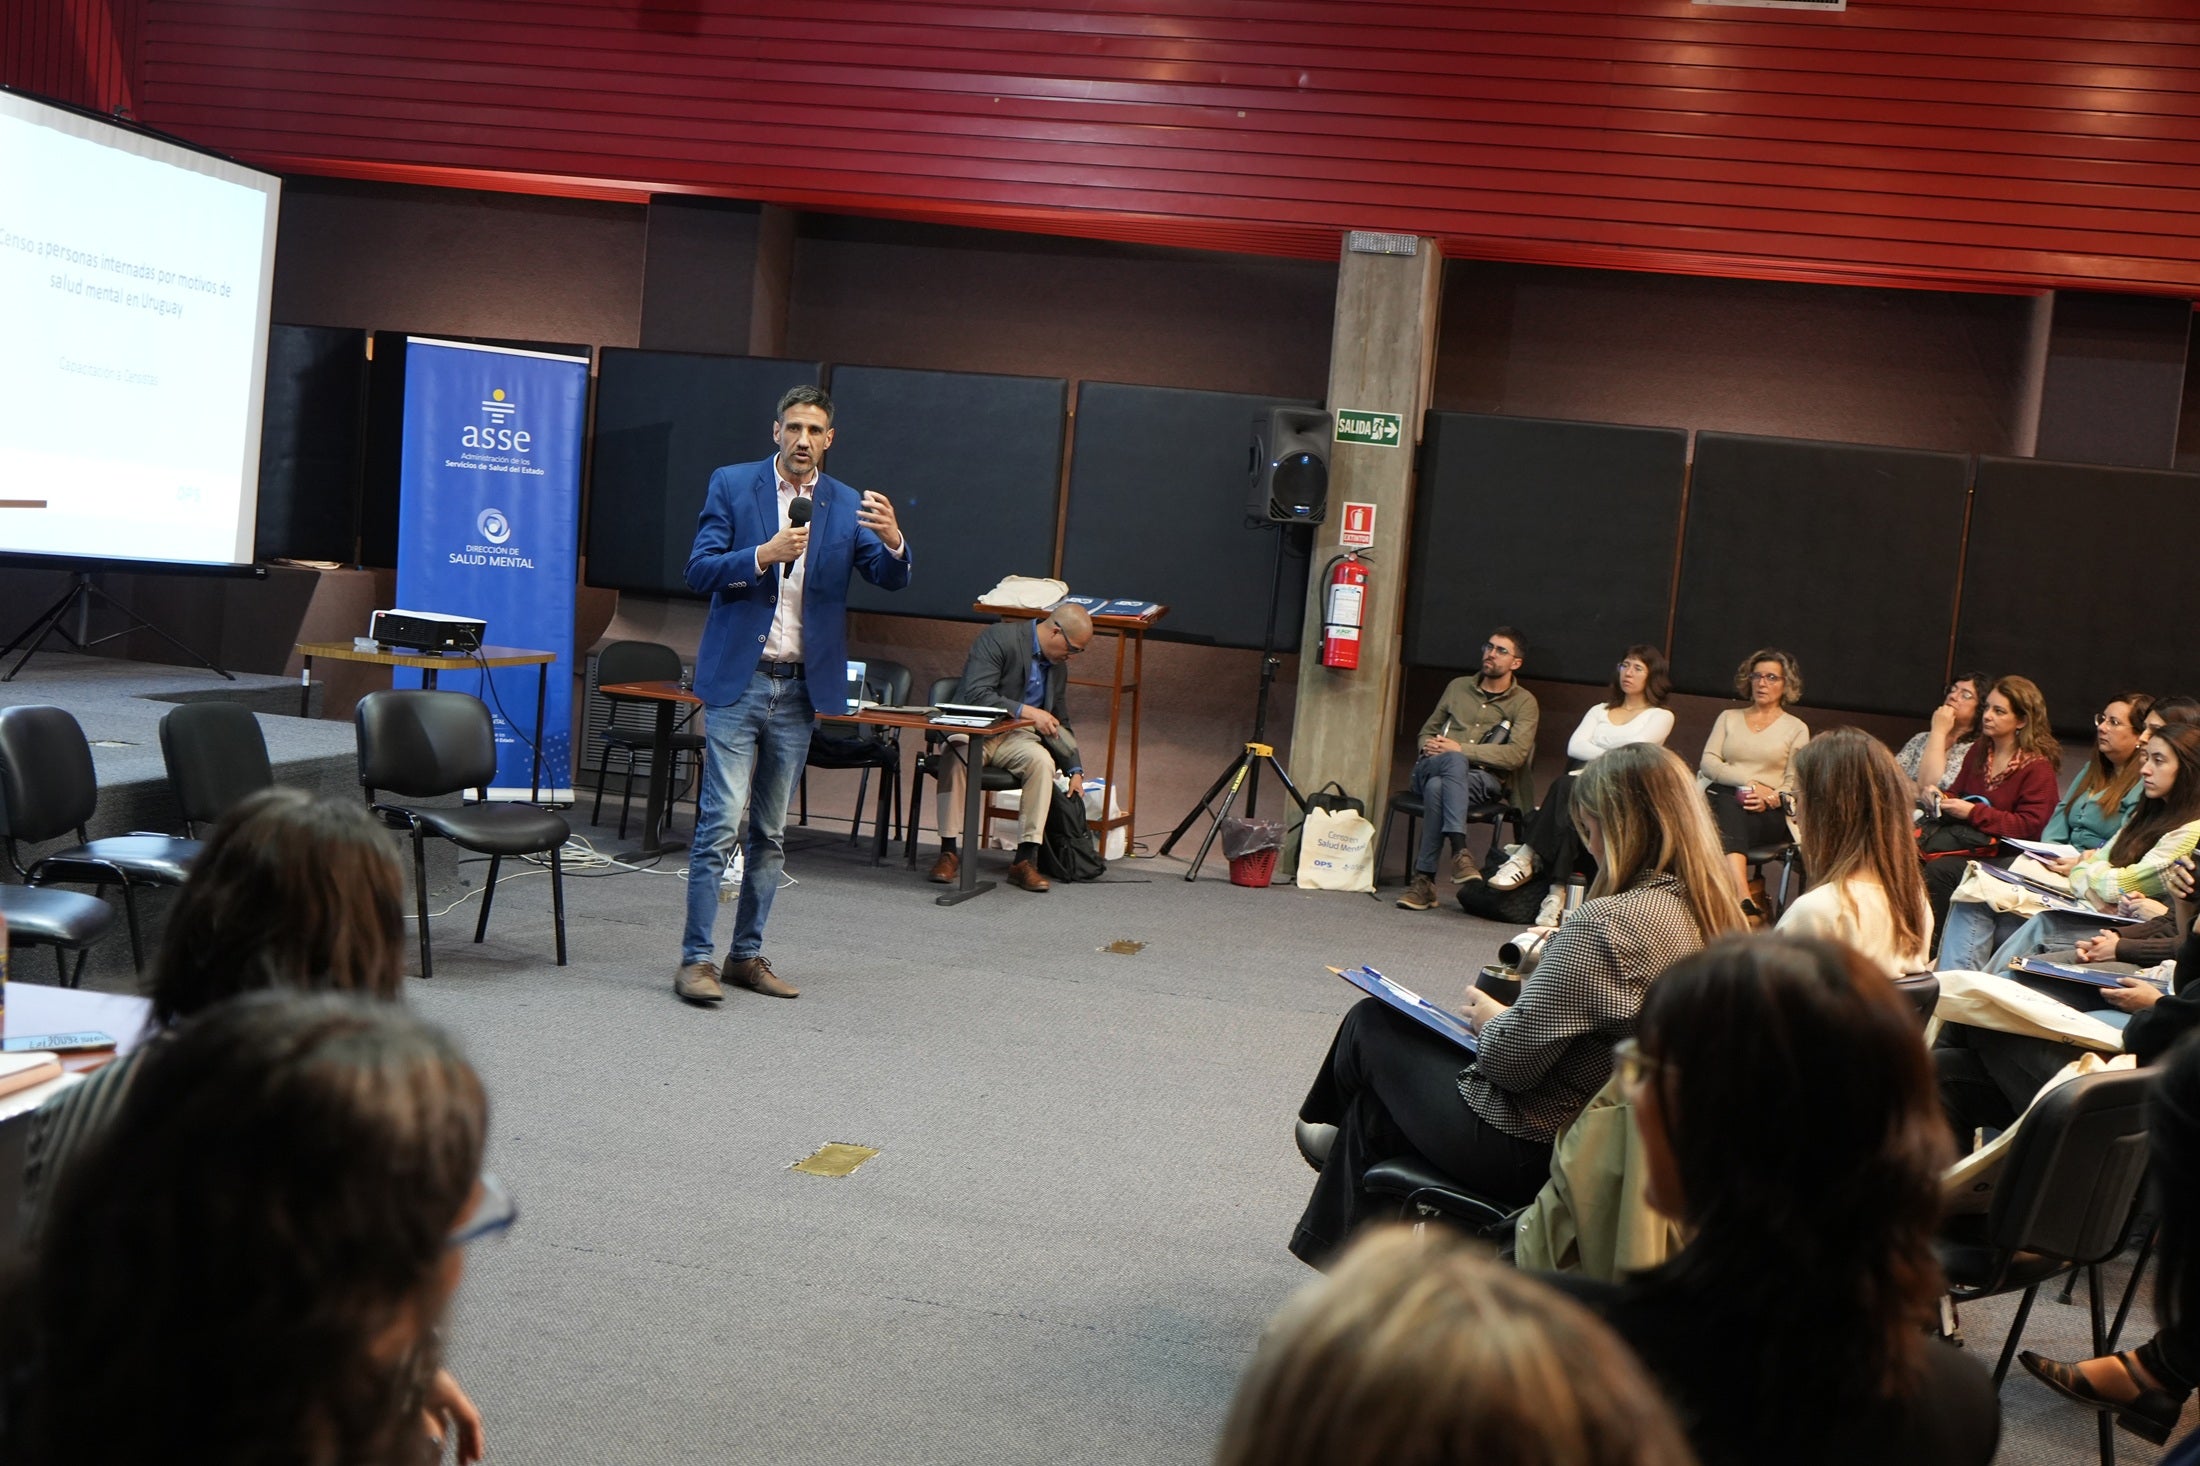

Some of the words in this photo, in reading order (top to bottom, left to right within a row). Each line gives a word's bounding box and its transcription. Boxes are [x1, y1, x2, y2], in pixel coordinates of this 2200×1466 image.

[37, 241, 44, 255] a
[45, 242, 98, 269] personas
[100, 253, 156, 281] internadas
[158, 269, 177, 286] por
[178, 273, 217, 295] motivos
[219, 281, 232, 298] de
[49, 273, 83, 296] salud
[85, 284, 124, 305] mental
[126, 293, 139, 308] en
[141, 292, 184, 319] Uruguay
[1338, 418, 1371, 436] SALIDA
[461, 425, 531, 453] asse
[461, 452, 510, 464] Administración
[510, 457, 519, 465] de
[521, 458, 531, 466] los
[445, 459, 477, 470] Servicios
[478, 462, 488, 470] de
[489, 463, 508, 473] Salud
[509, 465, 520, 473] del
[521, 467, 545, 476] Estado
[465, 544, 508, 555] DIRECCIÓN
[509, 548, 520, 556] DE
[449, 553, 487, 566] SALUD
[489, 556, 535, 569] MENTAL
[1317, 839, 1339, 849] Salud
[1314, 860, 1332, 868] OPS
